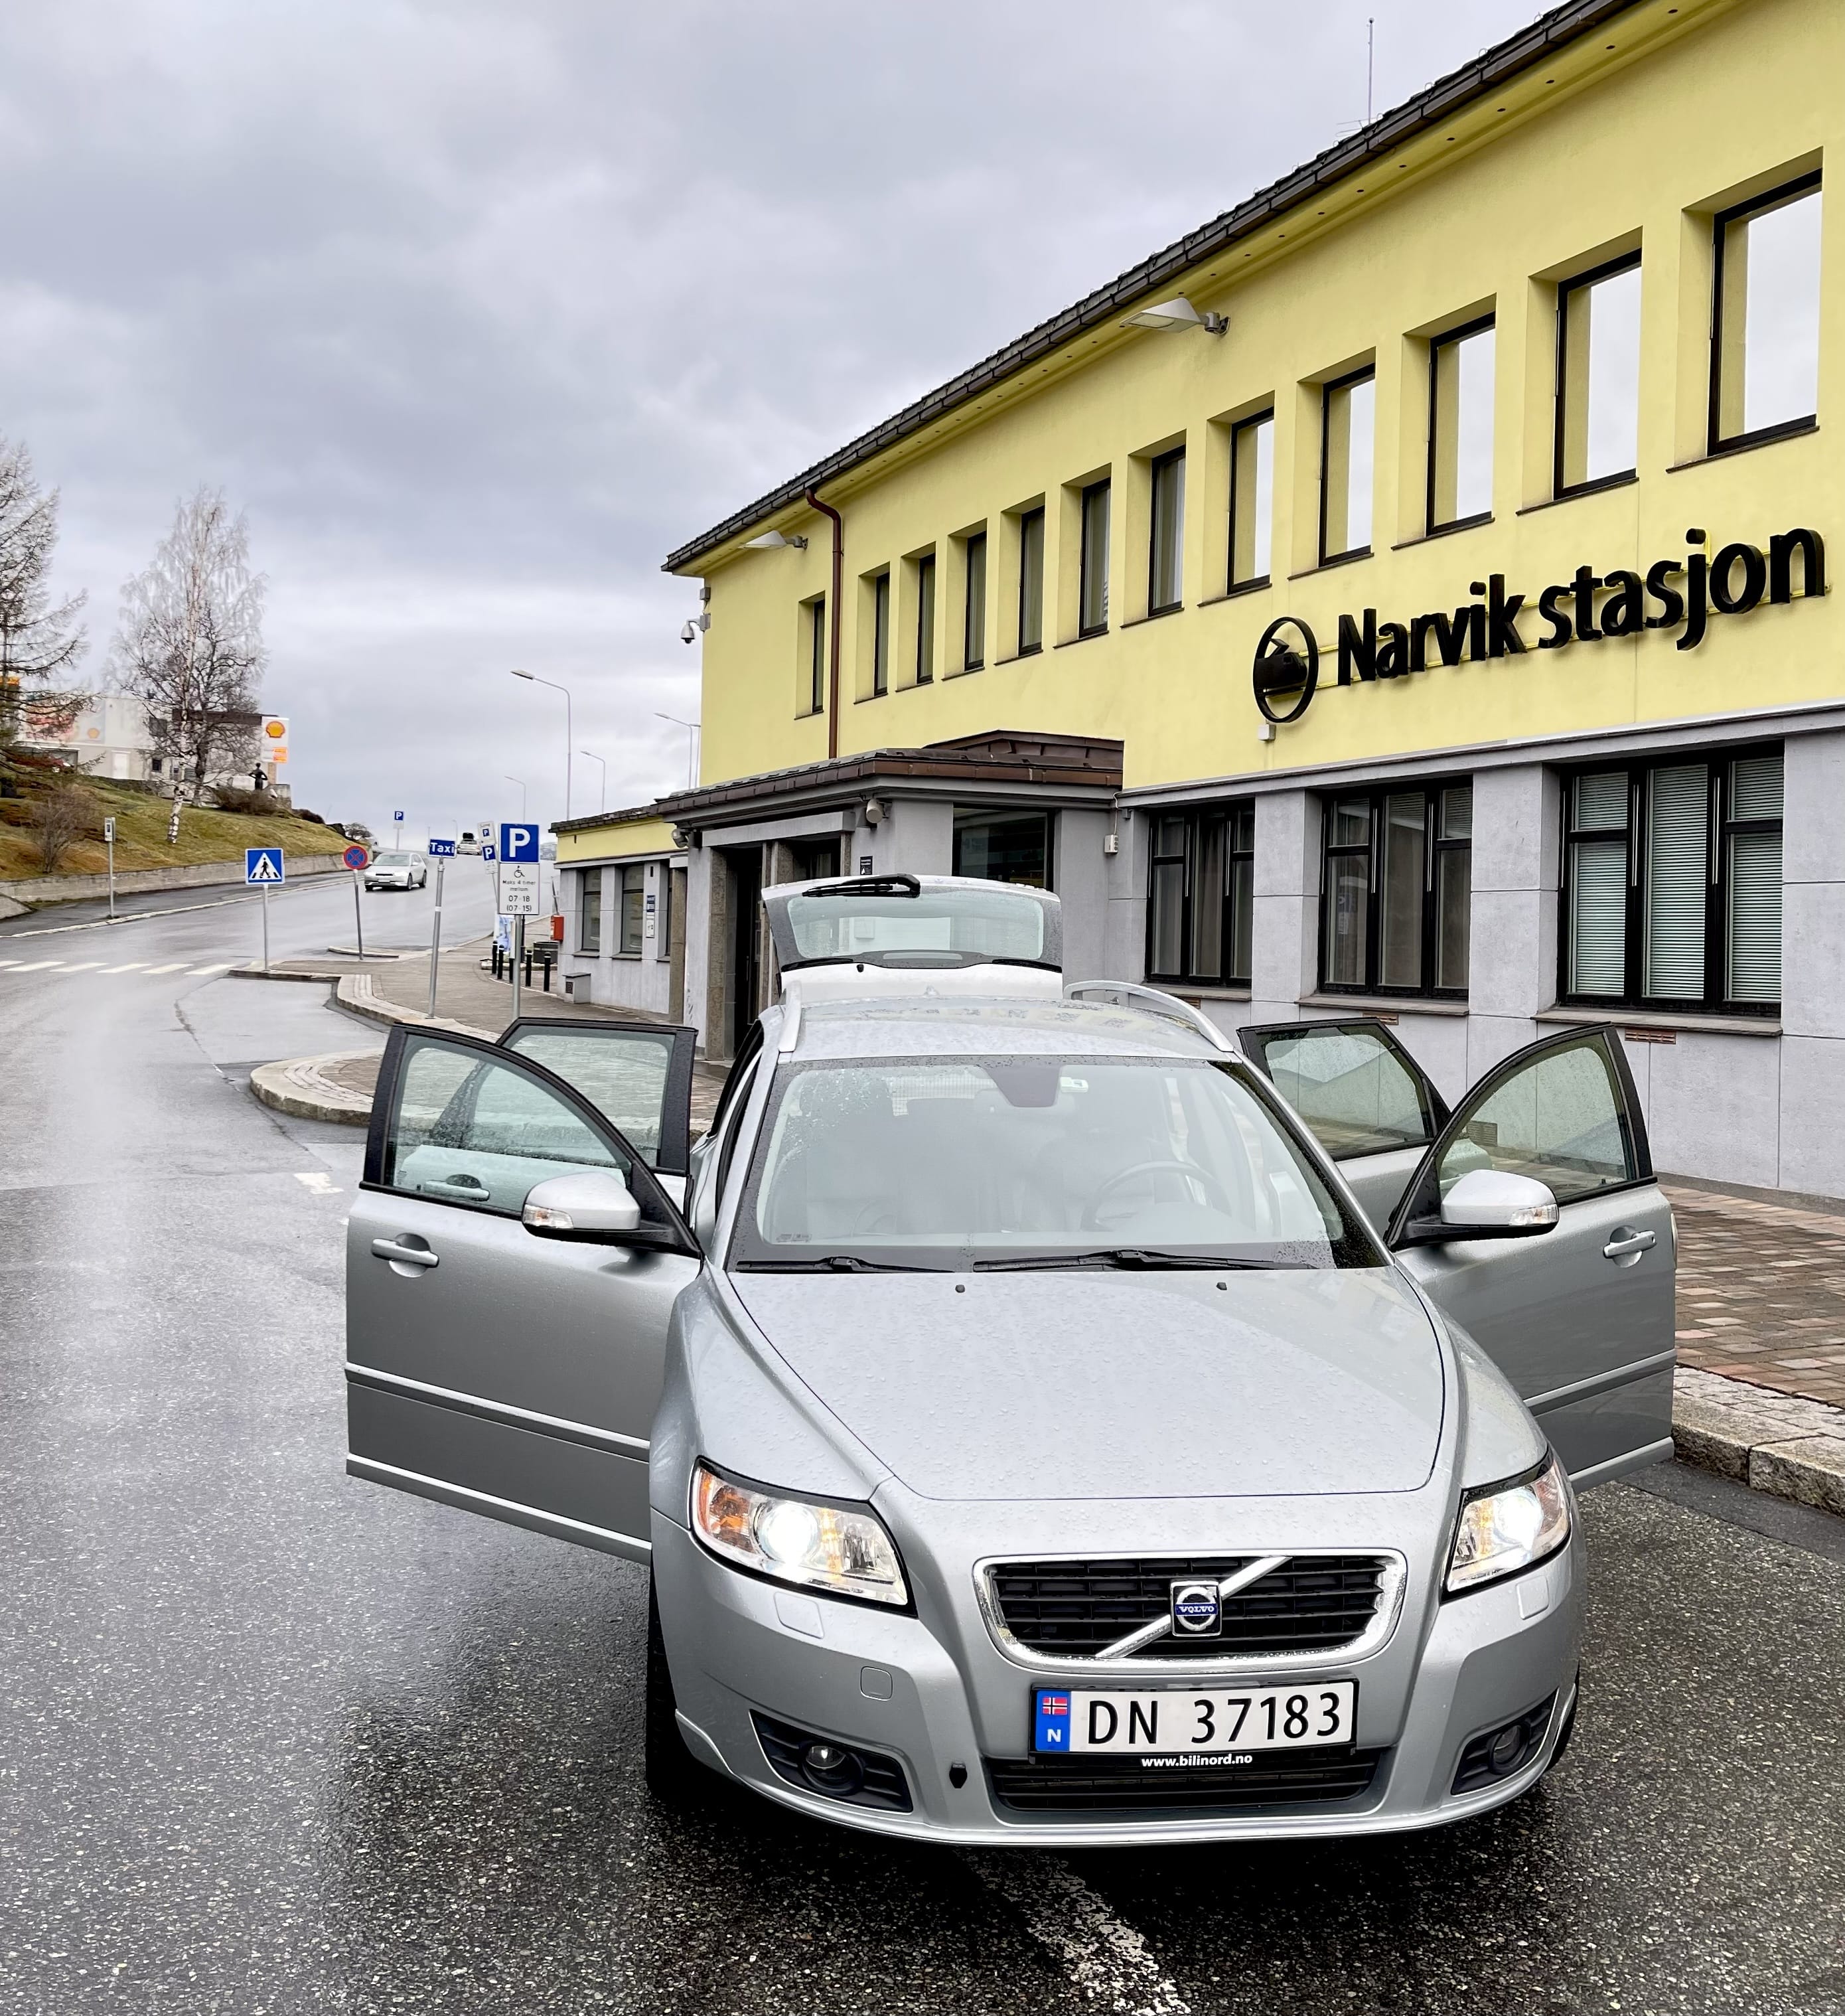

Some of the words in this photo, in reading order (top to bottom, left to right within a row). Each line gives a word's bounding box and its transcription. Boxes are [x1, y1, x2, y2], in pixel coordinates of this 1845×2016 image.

[1338, 573, 1526, 686] Narvik
[1538, 528, 1826, 651] stasjon
[396, 811, 402, 820] P
[430, 842, 455, 854] Taxi
[509, 828, 530, 858] P
[484, 847, 492, 859] P
[1088, 1700, 1157, 1745] DN
[1191, 1692, 1340, 1744] 37183
[1047, 1729, 1061, 1743] N
[1142, 1753, 1253, 1766] www.bilinord.no
